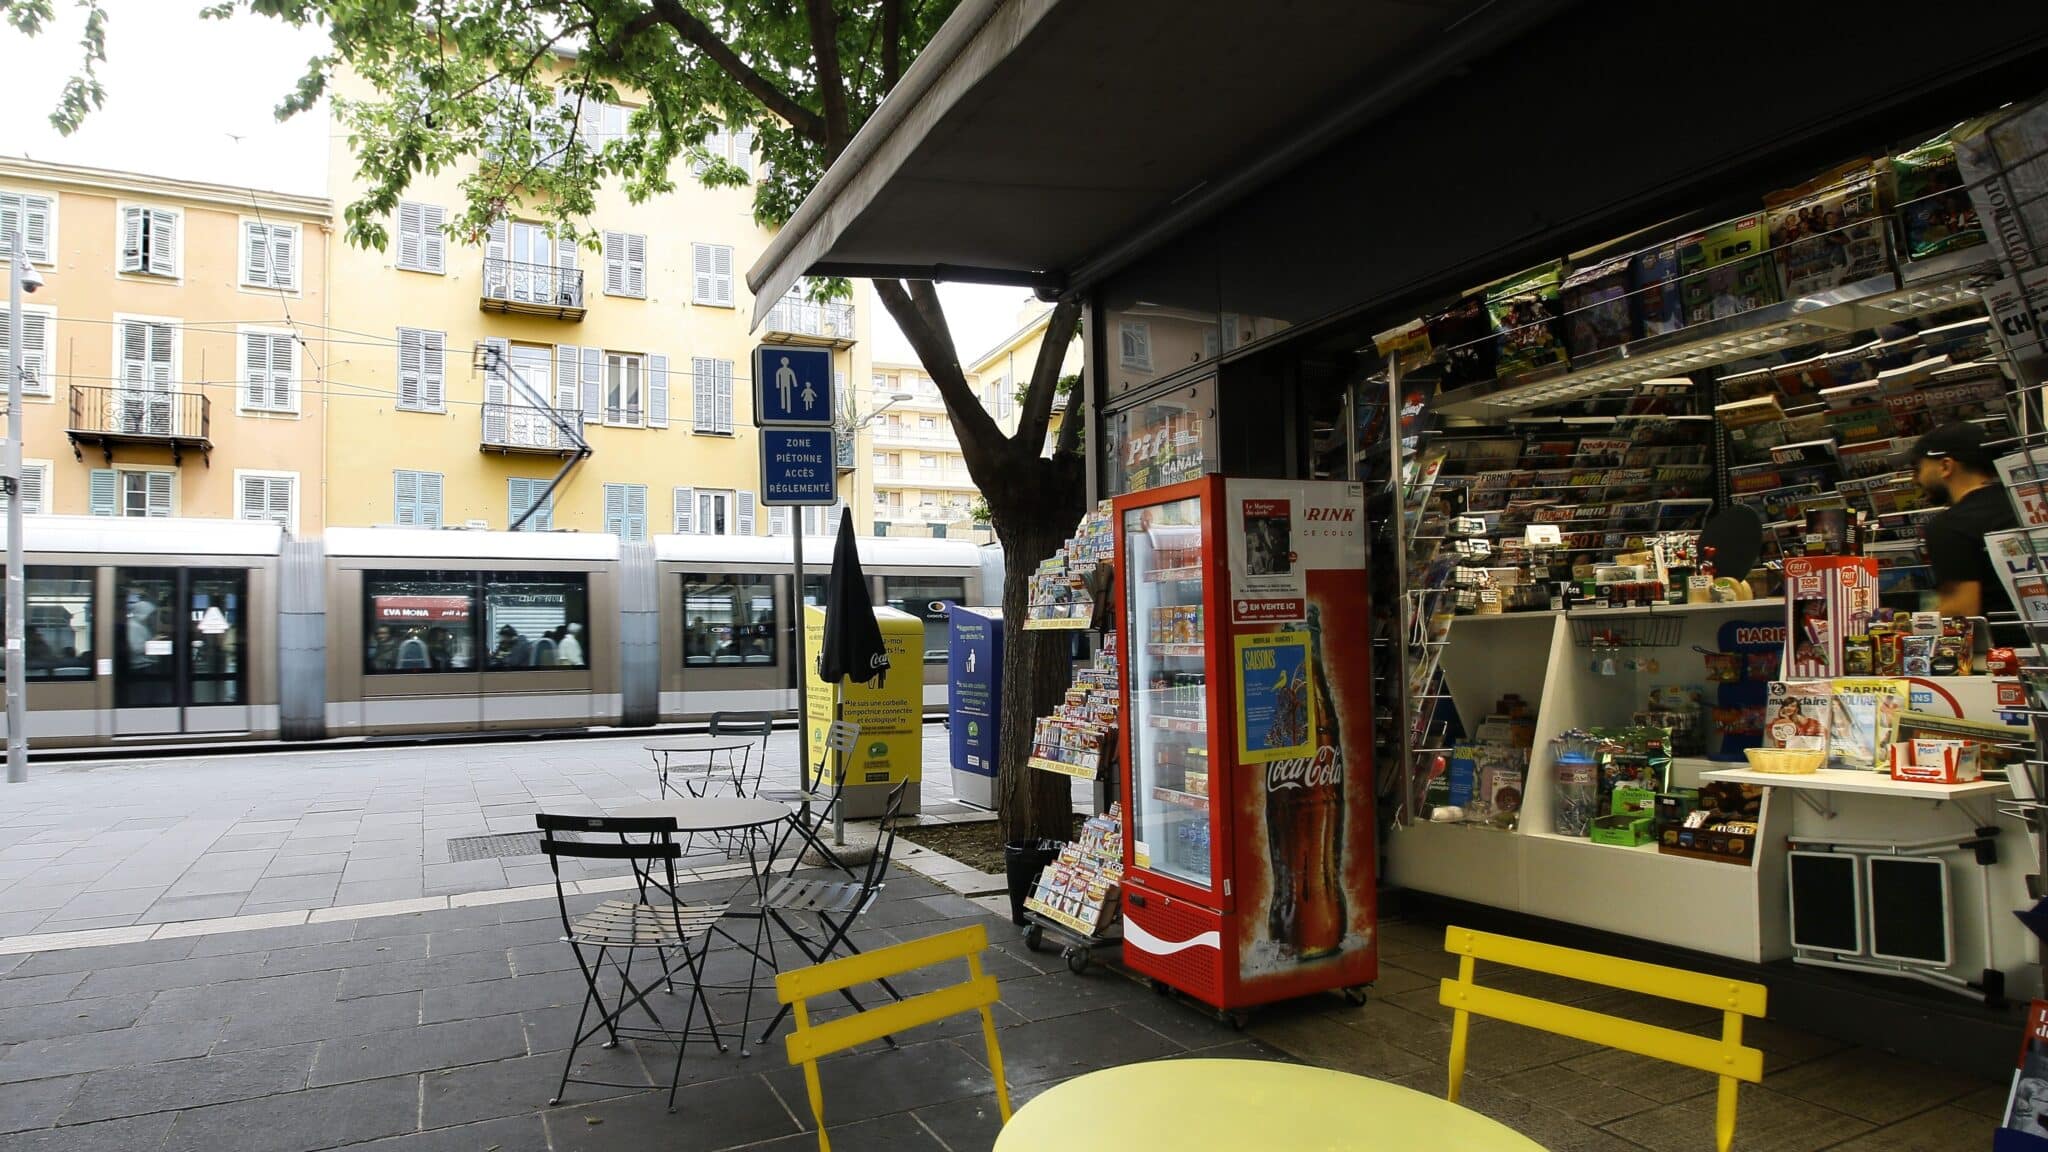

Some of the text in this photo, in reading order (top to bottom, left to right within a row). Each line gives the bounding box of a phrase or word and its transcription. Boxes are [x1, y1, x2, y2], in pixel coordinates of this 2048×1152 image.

[786, 439, 811, 447] ZONE
[776, 453, 823, 464] PIÉTONNE
[785, 468, 814, 478] ACCÈS
[769, 482, 830, 493] RÉGLEMENTÉ
[1303, 508, 1355, 521] RINK
[1249, 602, 1296, 611] EN VENTE ICI
[1245, 649, 1277, 671] SAISONS
